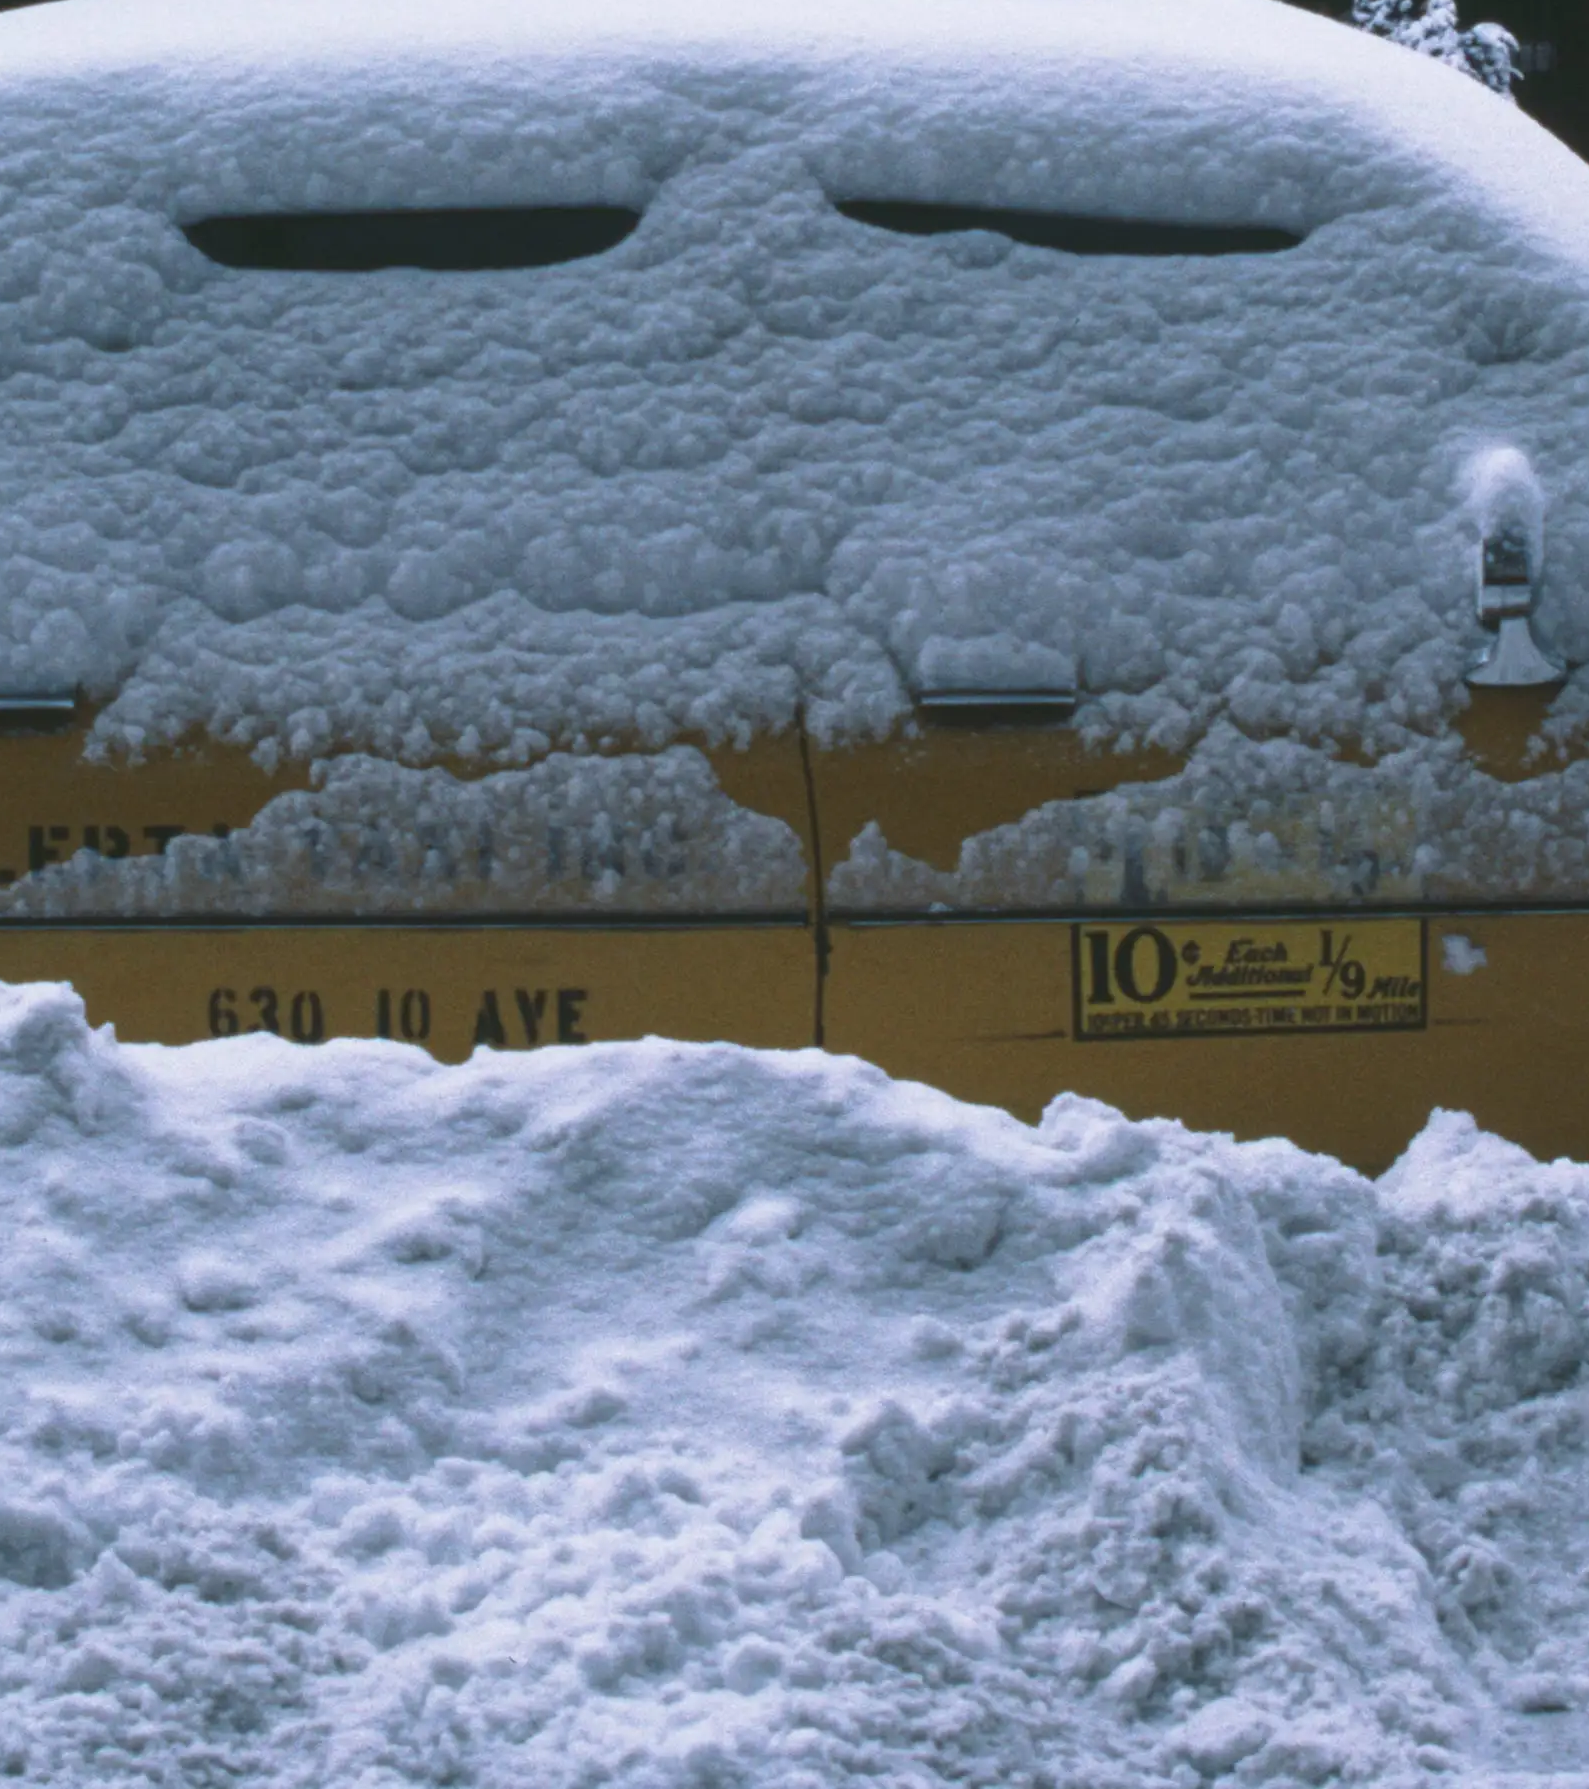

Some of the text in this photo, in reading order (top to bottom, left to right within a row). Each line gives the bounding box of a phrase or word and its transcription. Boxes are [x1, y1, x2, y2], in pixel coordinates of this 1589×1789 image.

[1186, 964, 1314, 988] Additional
[1225, 939, 1288, 964] Each
[1366, 974, 1419, 1000] Mile
[209, 988, 325, 1044] 630
[376, 988, 431, 1041] 10
